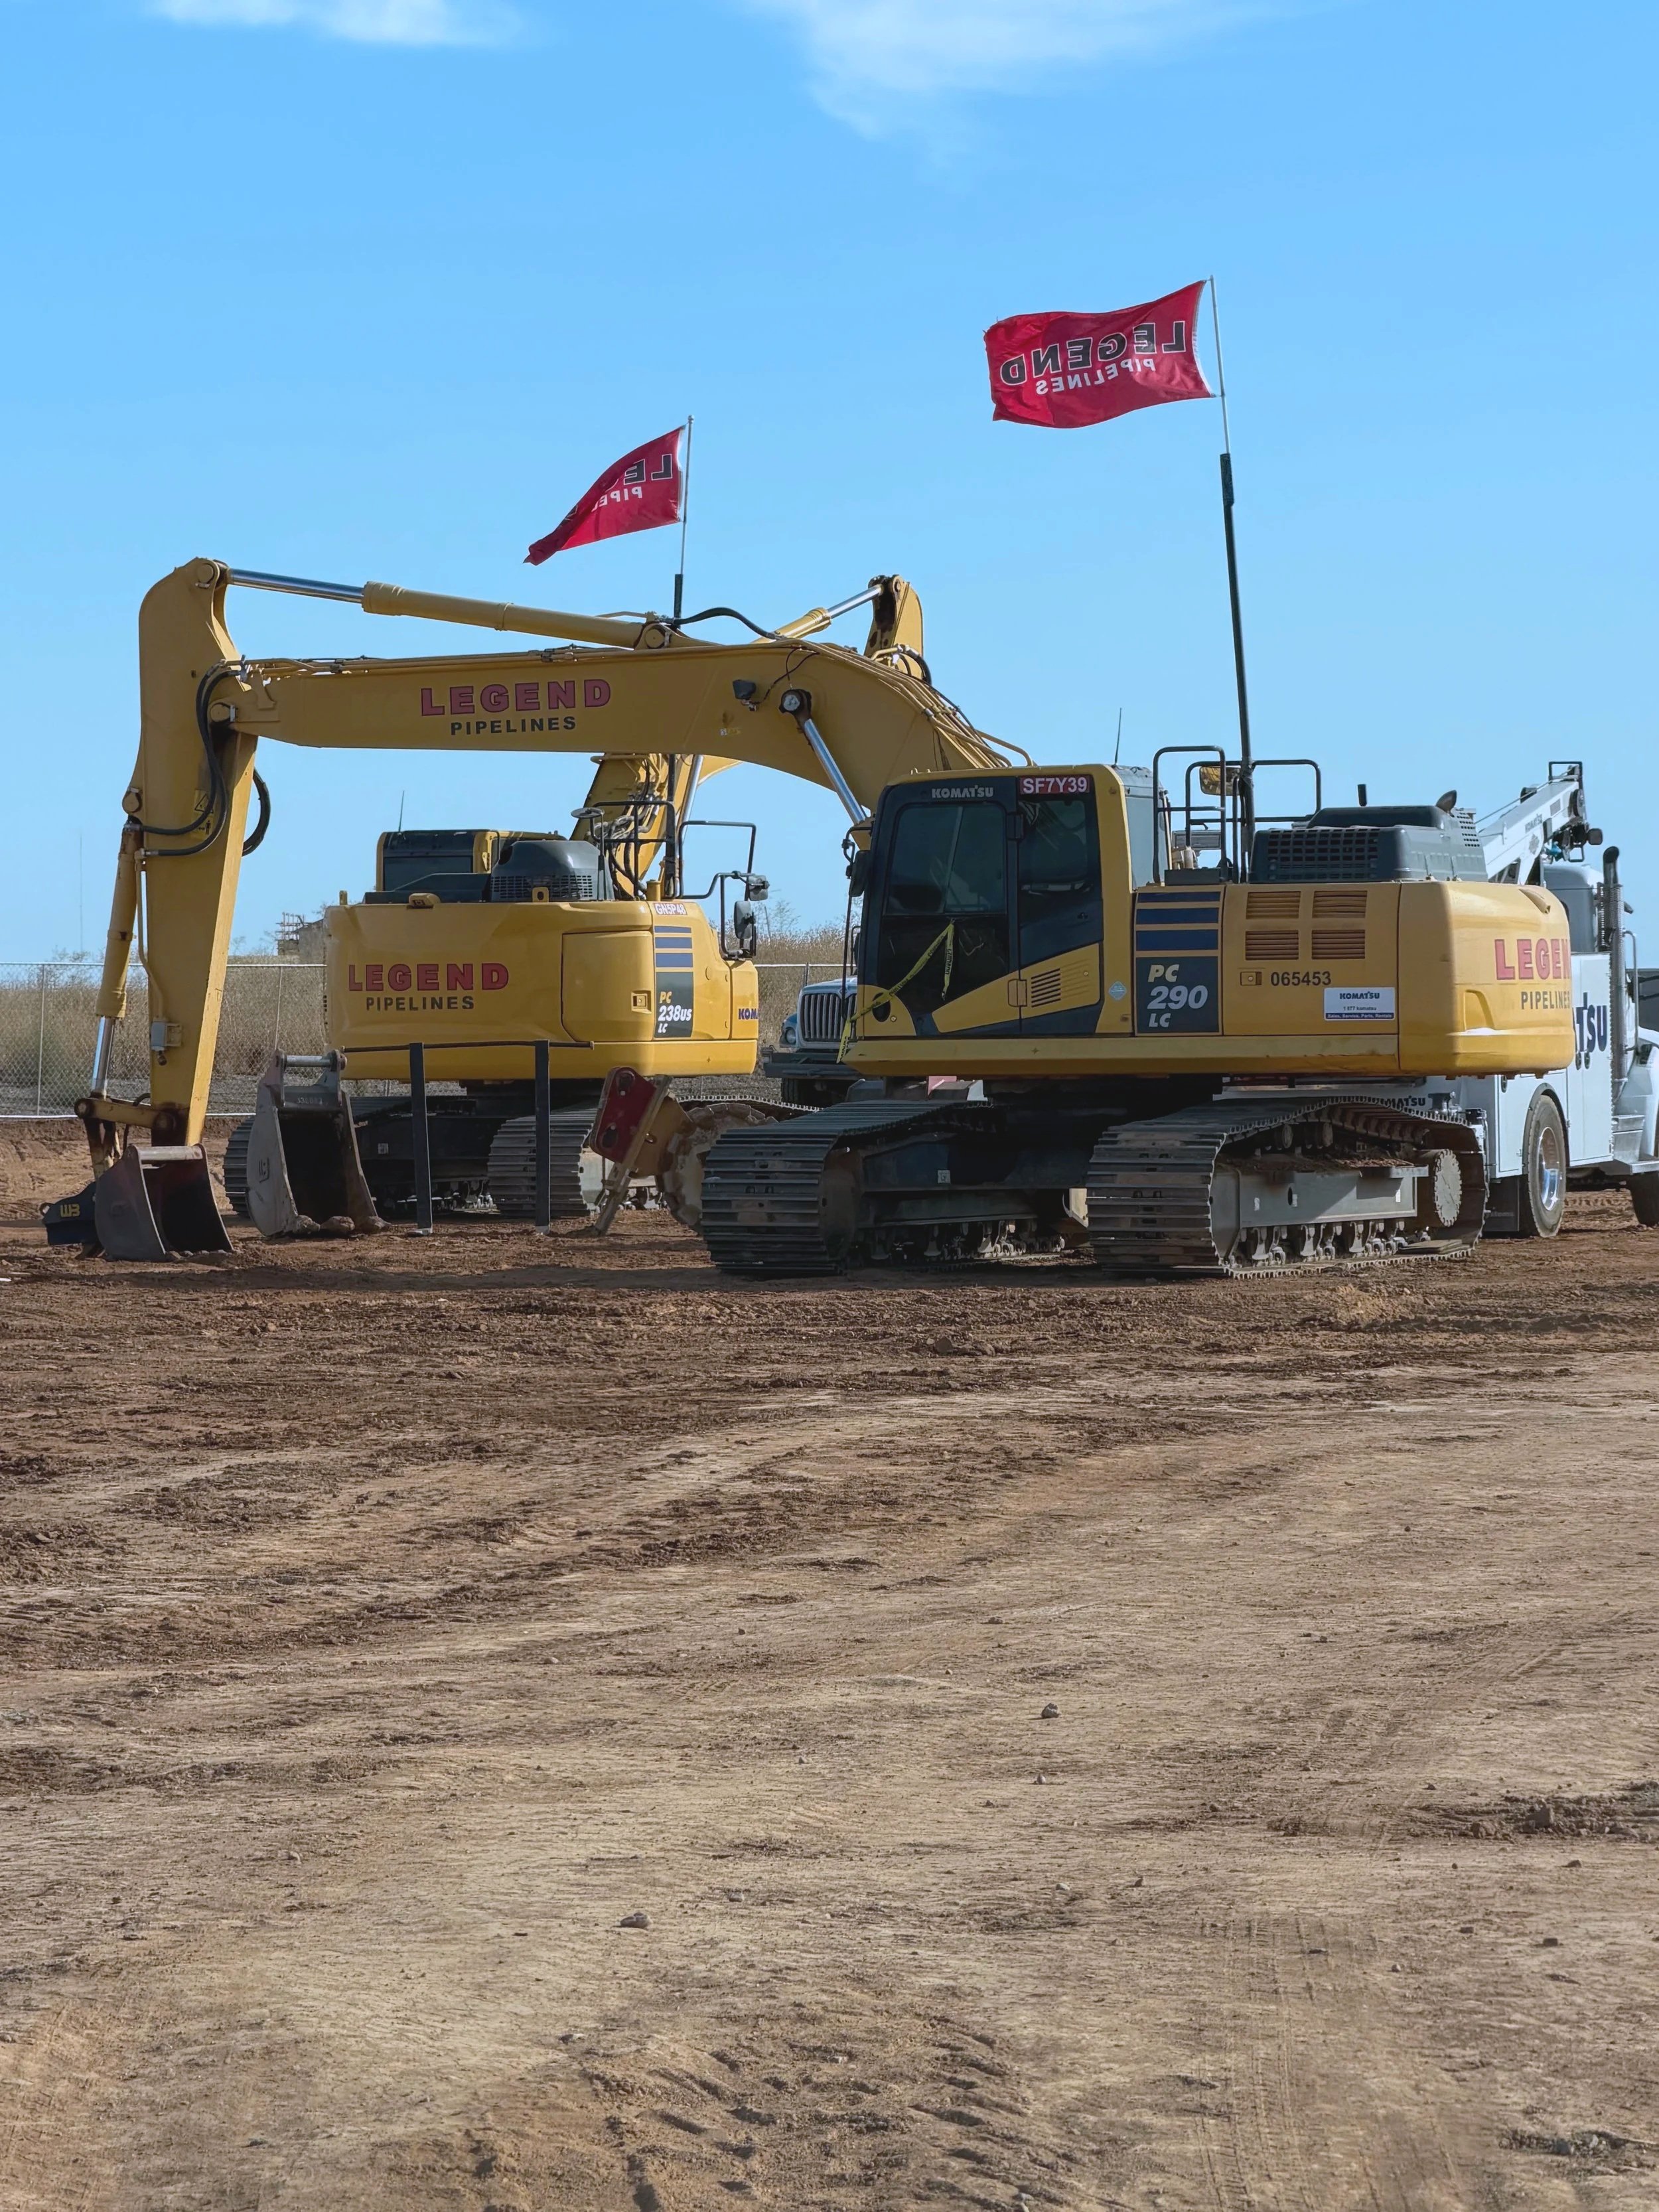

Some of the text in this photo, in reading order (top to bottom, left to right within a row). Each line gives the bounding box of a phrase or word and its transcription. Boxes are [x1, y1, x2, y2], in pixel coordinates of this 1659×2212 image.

[421, 679, 611, 716] LEGEND
[451, 716, 576, 735] PIPELINES
[932, 785, 993, 798] KOMATSU
[1023, 776, 1087, 794] SF7Y39
[348, 963, 509, 992] LEGEND
[1147, 964, 1180, 982] PC
[1271, 971, 1332, 986] 065453
[366, 995, 474, 1011] PIPELINES
[659, 991, 672, 1003] PC
[1147, 985, 1208, 1009] 290
[1339, 991, 1380, 999] KOMATSU
[738, 1008, 758, 1020] KOM
[1149, 1013, 1171, 1027] LC
[658, 1023, 668, 1033] LC
[1572, 992, 1608, 1053] TSU
